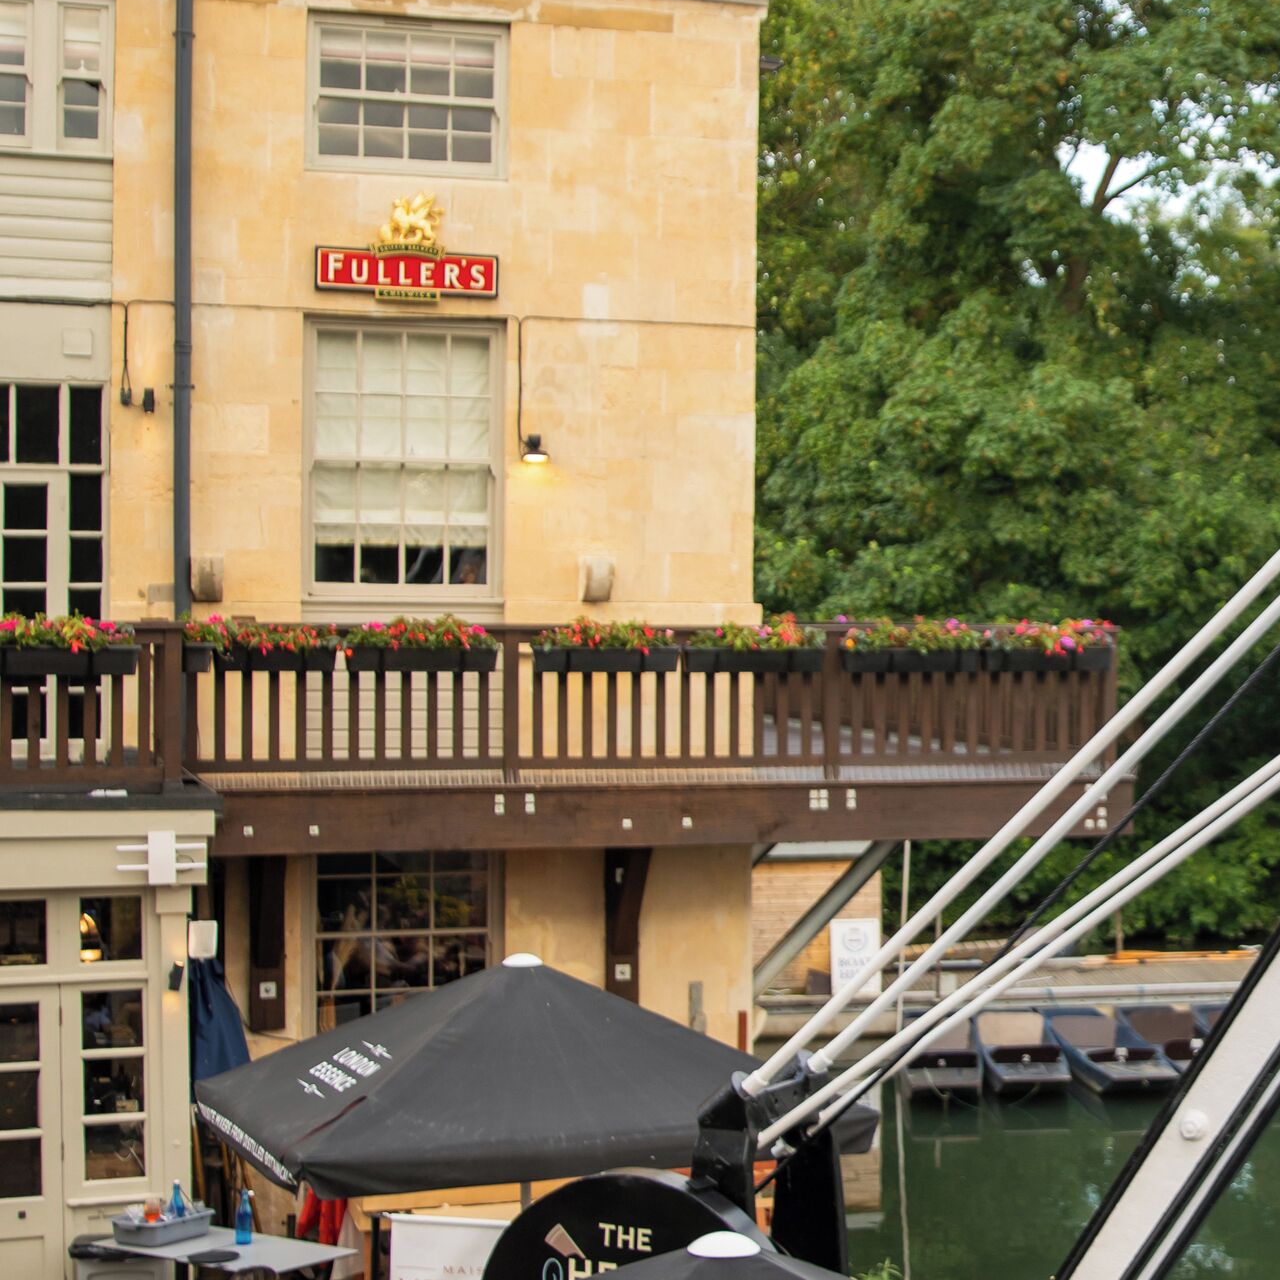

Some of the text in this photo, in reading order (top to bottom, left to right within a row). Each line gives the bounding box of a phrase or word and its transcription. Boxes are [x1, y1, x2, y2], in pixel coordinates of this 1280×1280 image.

[327, 252, 486, 289] FULLER'S
[309, 1061, 357, 1092] ESSENCE
[332, 1046, 381, 1077] LONDON
[598, 1222, 653, 1253] THE
